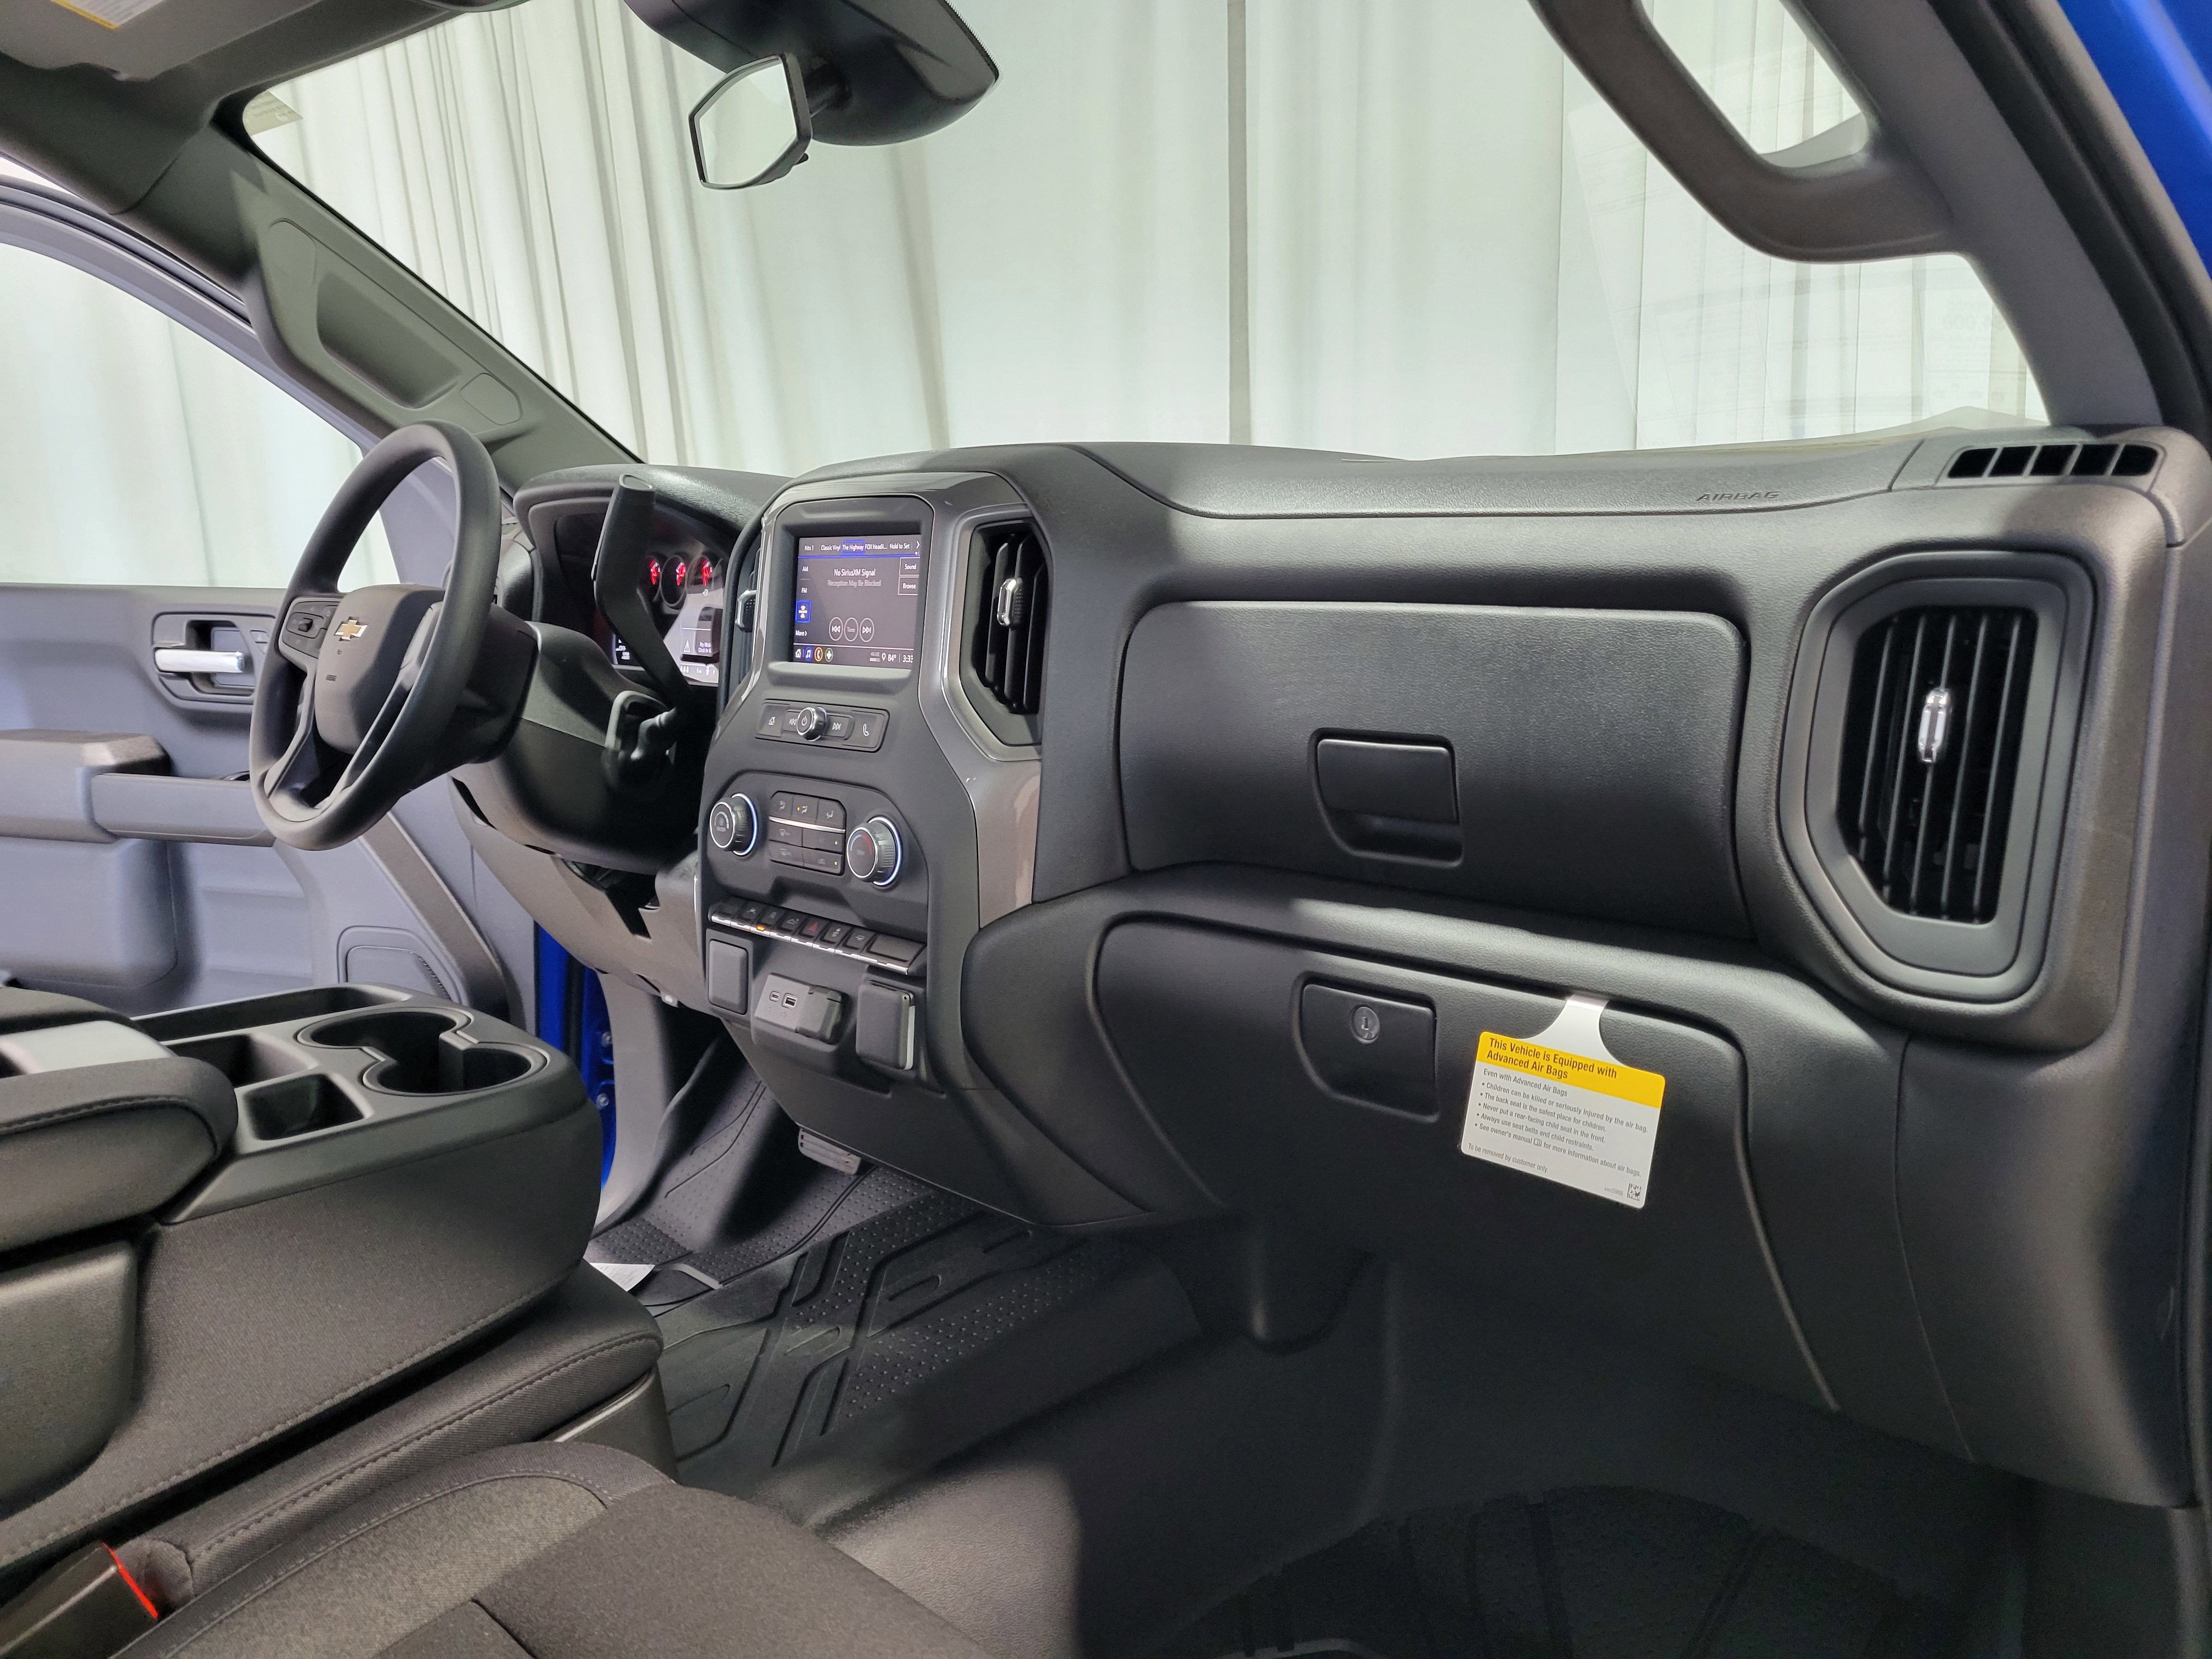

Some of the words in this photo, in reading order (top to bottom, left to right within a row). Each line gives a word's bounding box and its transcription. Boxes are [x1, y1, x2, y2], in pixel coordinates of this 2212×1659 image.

[1696, 490, 1781, 501] AIRBAG
[841, 568, 861, 577] SiriusXM
[861, 568, 876, 578] Signal
[1487, 1049, 1529, 1069] Advanced
[1531, 1061, 1544, 1072] Air
[1546, 1065, 1568, 1079] Bags
[1489, 1037, 1507, 1051] This
[1510, 1042, 1541, 1059] Vehicle
[1543, 1051, 1550, 1062] is
[1553, 1054, 1594, 1073] Equipped
[1597, 1065, 1617, 1079] with
[1483, 1068, 1498, 1078] Even
[1499, 1073, 1511, 1081] with
[1513, 1076, 1541, 1090] Advanced
[1553, 1087, 1567, 1097] Bags
[1482, 1102, 1498, 1111] Never
[1514, 1112, 1544, 1126] rear-facing
[1545, 1121, 1559, 1130] child
[1560, 1125, 1572, 1133] seat
[1590, 1133, 1605, 1143] front.
[1485, 1092, 1494, 1101] The
[1496, 1095, 1509, 1104] back
[1510, 1100, 1521, 1108] seat
[1529, 1104, 1537, 1113] the
[1539, 1109, 1555, 1118] safest
[1556, 1113, 1571, 1121] place
[1582, 1120, 1606, 1132] children.
[1486, 1082, 1509, 1094] Children
[1523, 1091, 1530, 1099] be
[1531, 1094, 1547, 1104] killed
[1556, 1101, 1582, 1115] seriously
[1583, 1108, 1604, 1120] injured
[1605, 1114, 1613, 1123] by
[1614, 1117, 1624, 1125] the
[1635, 1123, 1648, 1133] bag.
[1479, 1123, 1489, 1131] See
[1491, 1127, 1511, 1137] owner's
[1513, 1133, 1532, 1143] manual
[1552, 1145, 1566, 1154] more
[1567, 1149, 1599, 1164] information
[1600, 1159, 1616, 1169] about
[1627, 1166, 1641, 1177] bags.
[1481, 1113, 1500, 1124] Always
[1525, 1125, 1538, 1135] belts
[1551, 1133, 1564, 1142] child
[1566, 1138, 1594, 1151] restraints.
[1482, 1148, 1504, 1159] removed
[1505, 1154, 1511, 1163] by
[1513, 1157, 1536, 1169] customer
